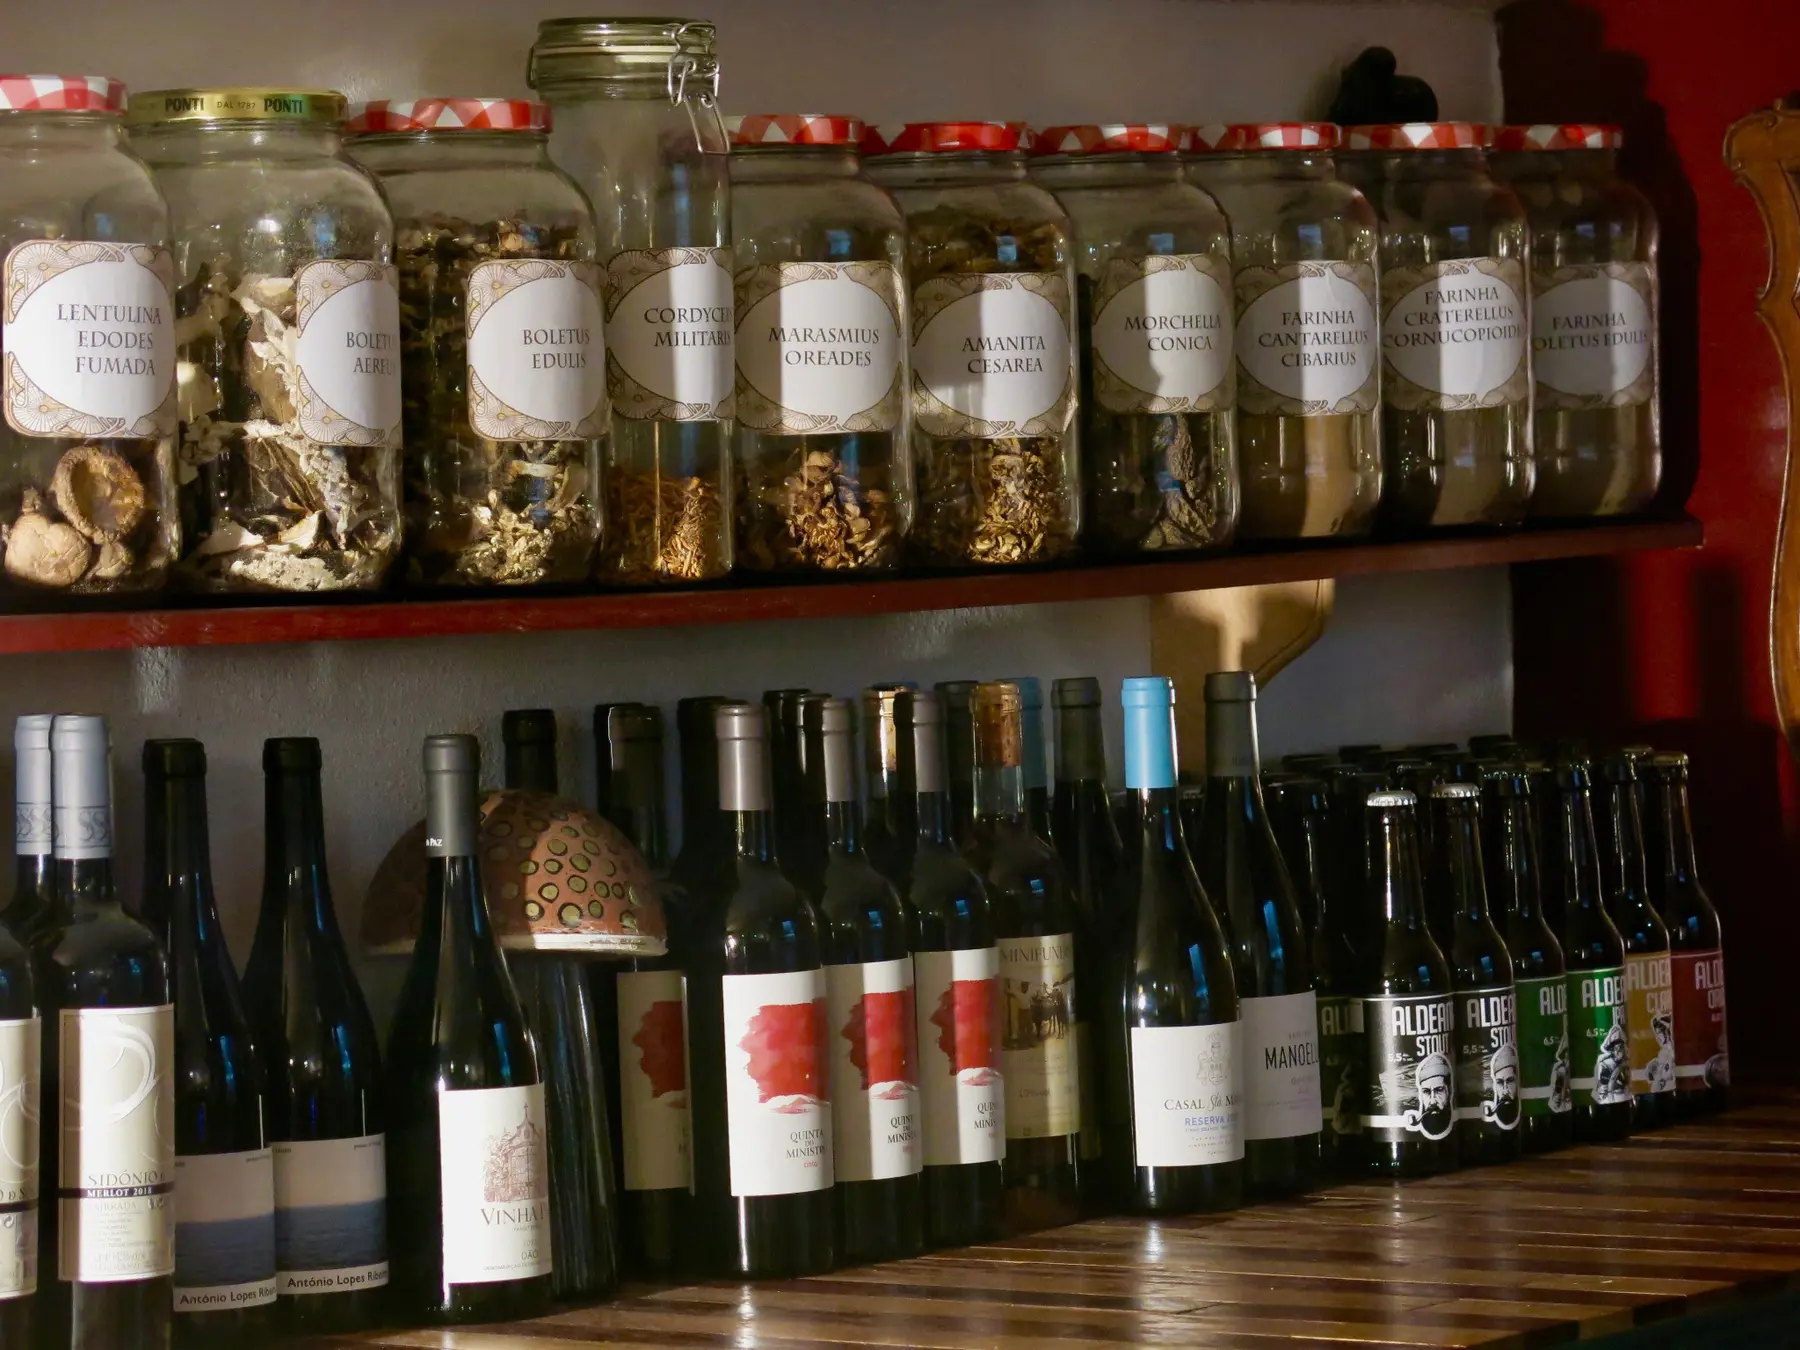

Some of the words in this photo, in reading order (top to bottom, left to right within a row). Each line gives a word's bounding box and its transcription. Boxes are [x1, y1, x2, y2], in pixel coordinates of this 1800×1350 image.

[164, 97, 204, 112] PONTI
[263, 97, 302, 113] PONTI
[1425, 286, 1499, 305] FARINHA
[56, 303, 161, 325] LENTULINA
[1124, 314, 1222, 331] MORCHELLA
[1281, 310, 1355, 326] FARINHA
[1404, 305, 1513, 327] CRATERELLUS
[1552, 312, 1626, 331] FARINHA
[77, 330, 153, 350] EDODES
[522, 328, 590, 346] BOLETUS
[768, 327, 880, 344] MARASMIUS
[961, 335, 1047, 352] AMANITA
[1147, 335, 1212, 352] CONICA
[1257, 330, 1369, 348] CANTARELLUS
[75, 356, 156, 376] FUMADA
[532, 352, 587, 369] EDULIS
[785, 350, 872, 367] OREADES
[967, 357, 1043, 375] CESAREA
[1281, 351, 1357, 368] CIBARIUS
[1416, 1033, 1449, 1057] STOUT
[1164, 1098, 1205, 1111] CASAL
[1184, 1115, 1225, 1126] RESERVA
[790, 1128, 824, 1143] QUINTA
[88, 1169, 157, 1186] SIDÓNIO
[87, 1189, 129, 1198] MERLOT
[133, 1187, 151, 1196] 2018
[287, 1276, 333, 1288] António
[337, 1274, 365, 1286] Lopes
[180, 1295, 227, 1306] António
[230, 1291, 257, 1303] Lopes
